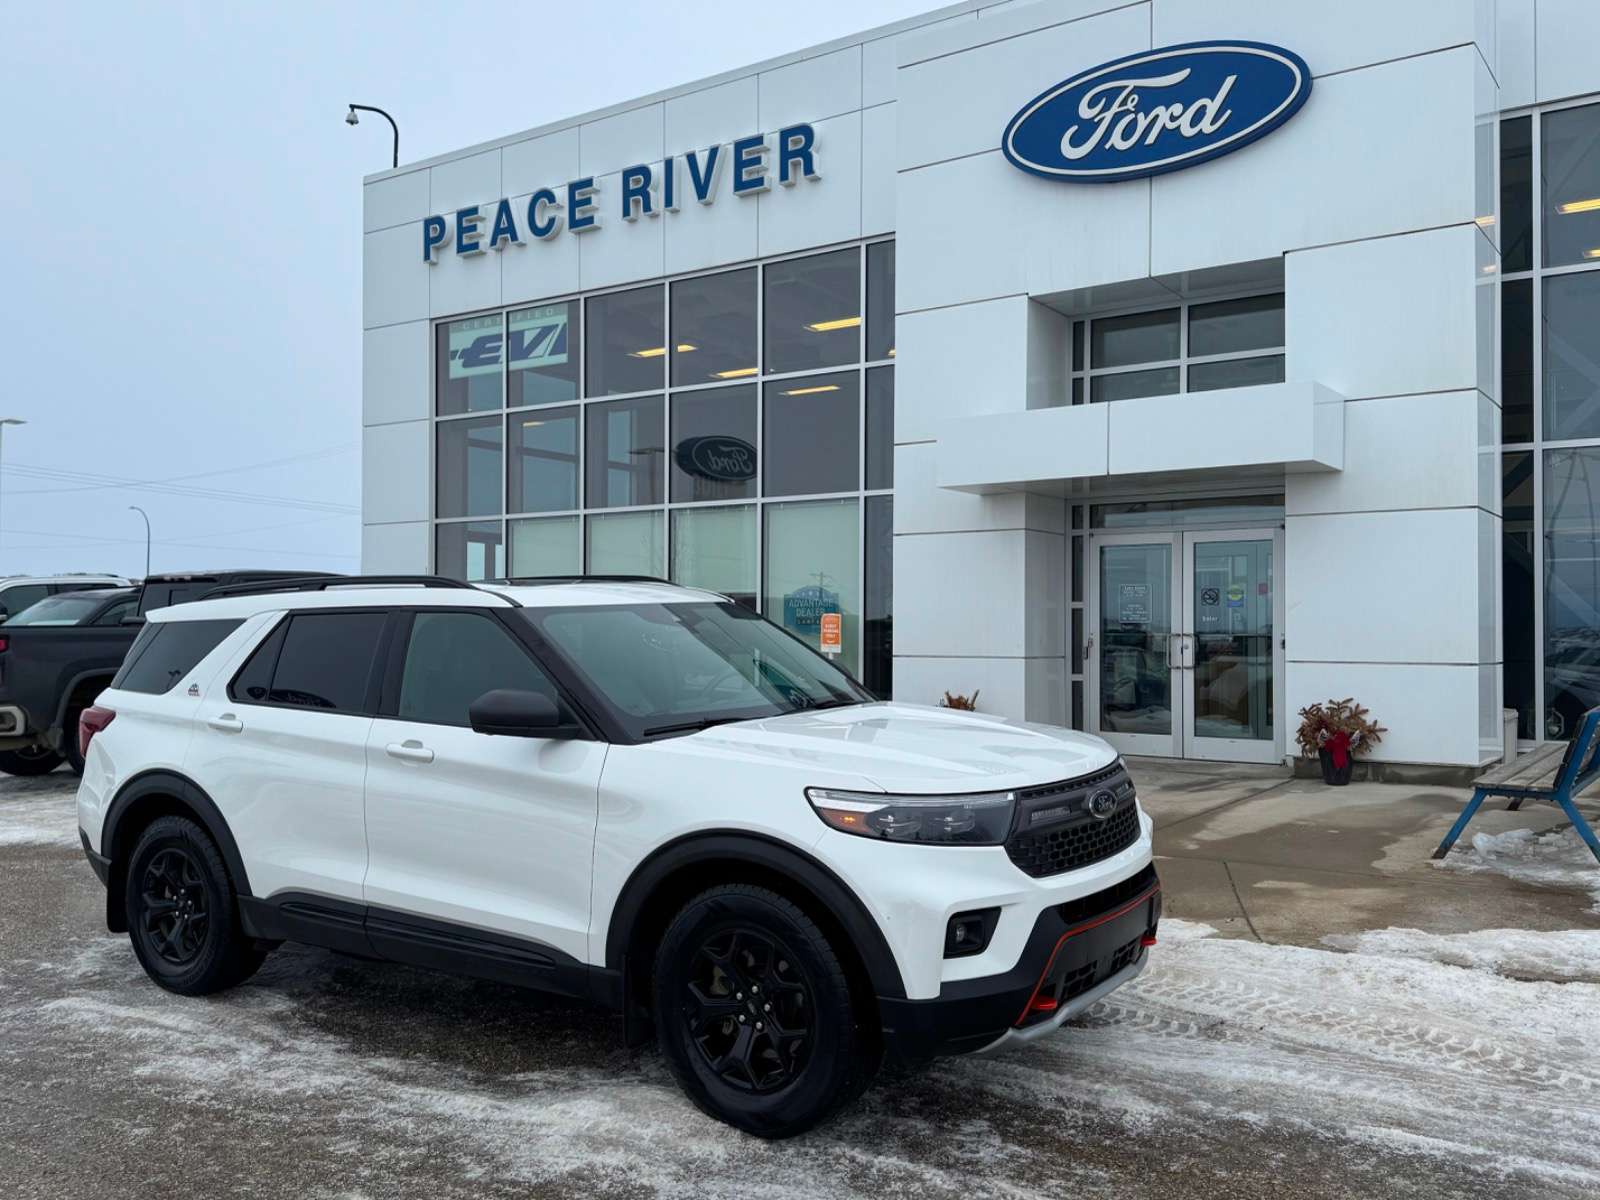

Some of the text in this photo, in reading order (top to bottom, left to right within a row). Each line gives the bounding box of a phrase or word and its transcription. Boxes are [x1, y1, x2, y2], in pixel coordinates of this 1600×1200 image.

[1060, 66, 1238, 161] Ford
[422, 122, 817, 264] PEACE RIVER
